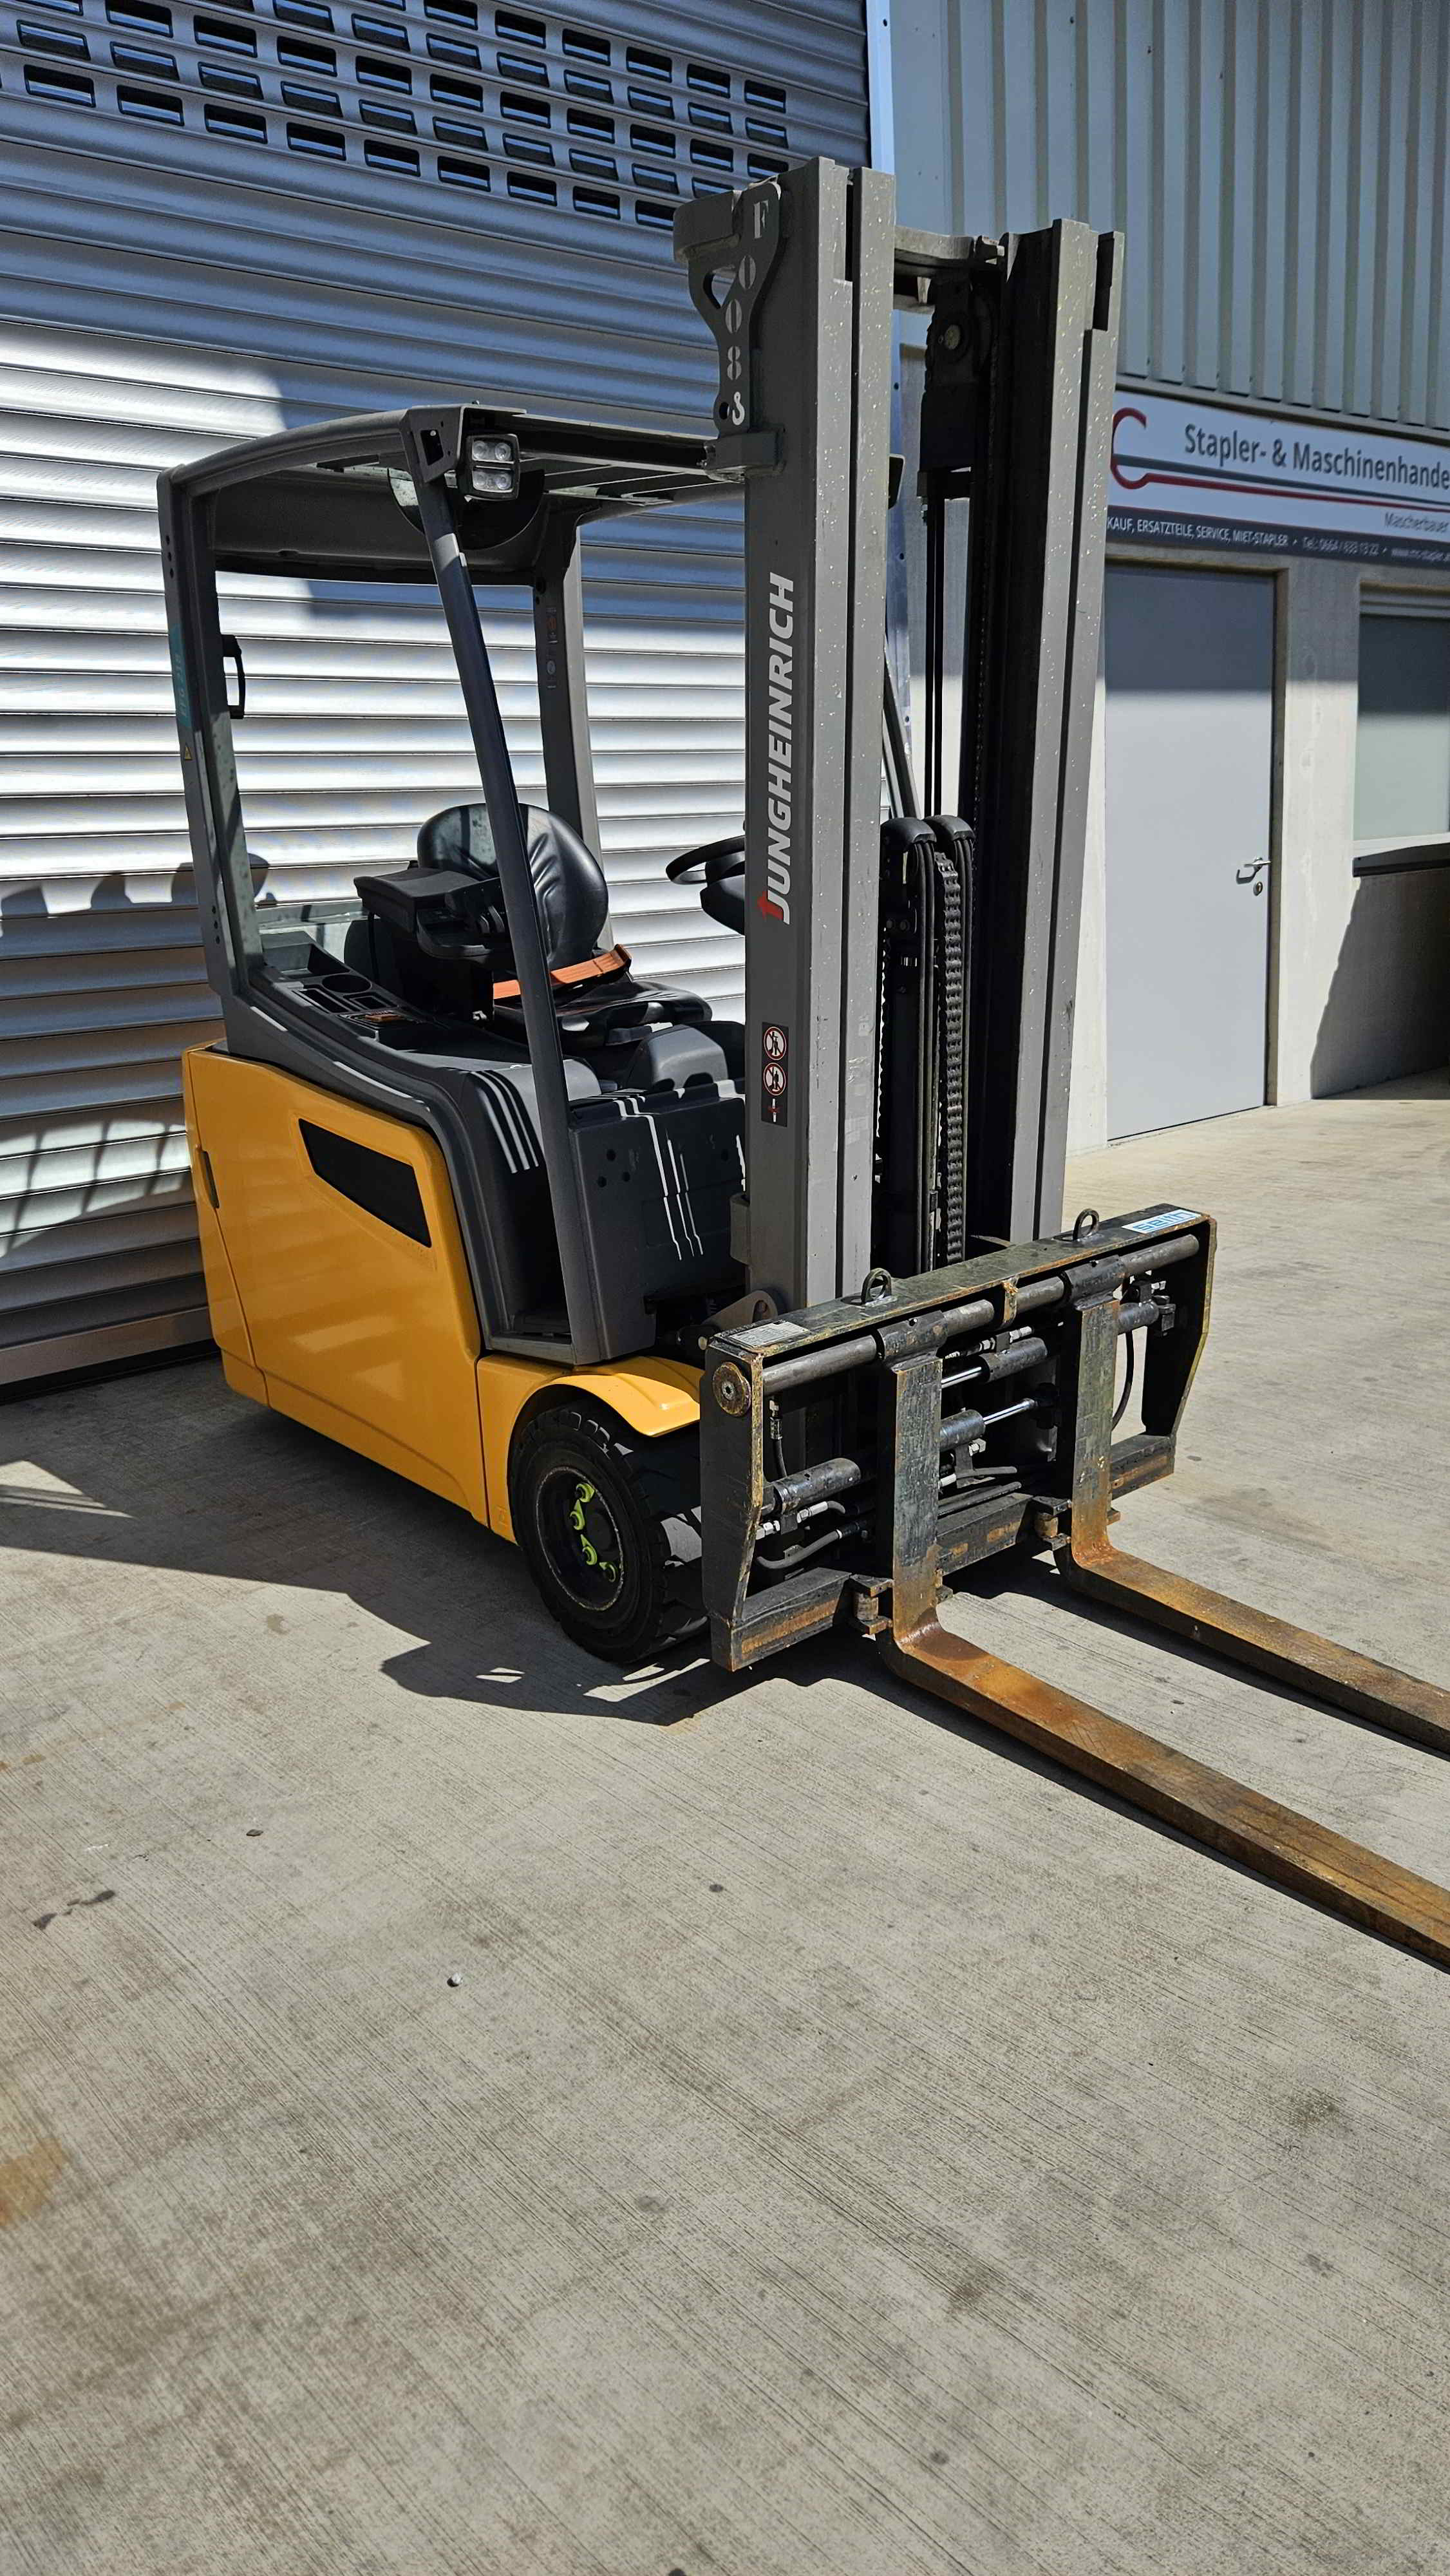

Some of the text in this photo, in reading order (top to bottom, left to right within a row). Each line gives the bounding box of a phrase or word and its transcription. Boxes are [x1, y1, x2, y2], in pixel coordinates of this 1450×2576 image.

[1272, 438, 1286, 468] &
[1137, 519, 1195, 540] ERSATZTEILE,
[1196, 525, 1231, 544] SERVICE,
[758, 571, 794, 925] JUNGHEINRICH
